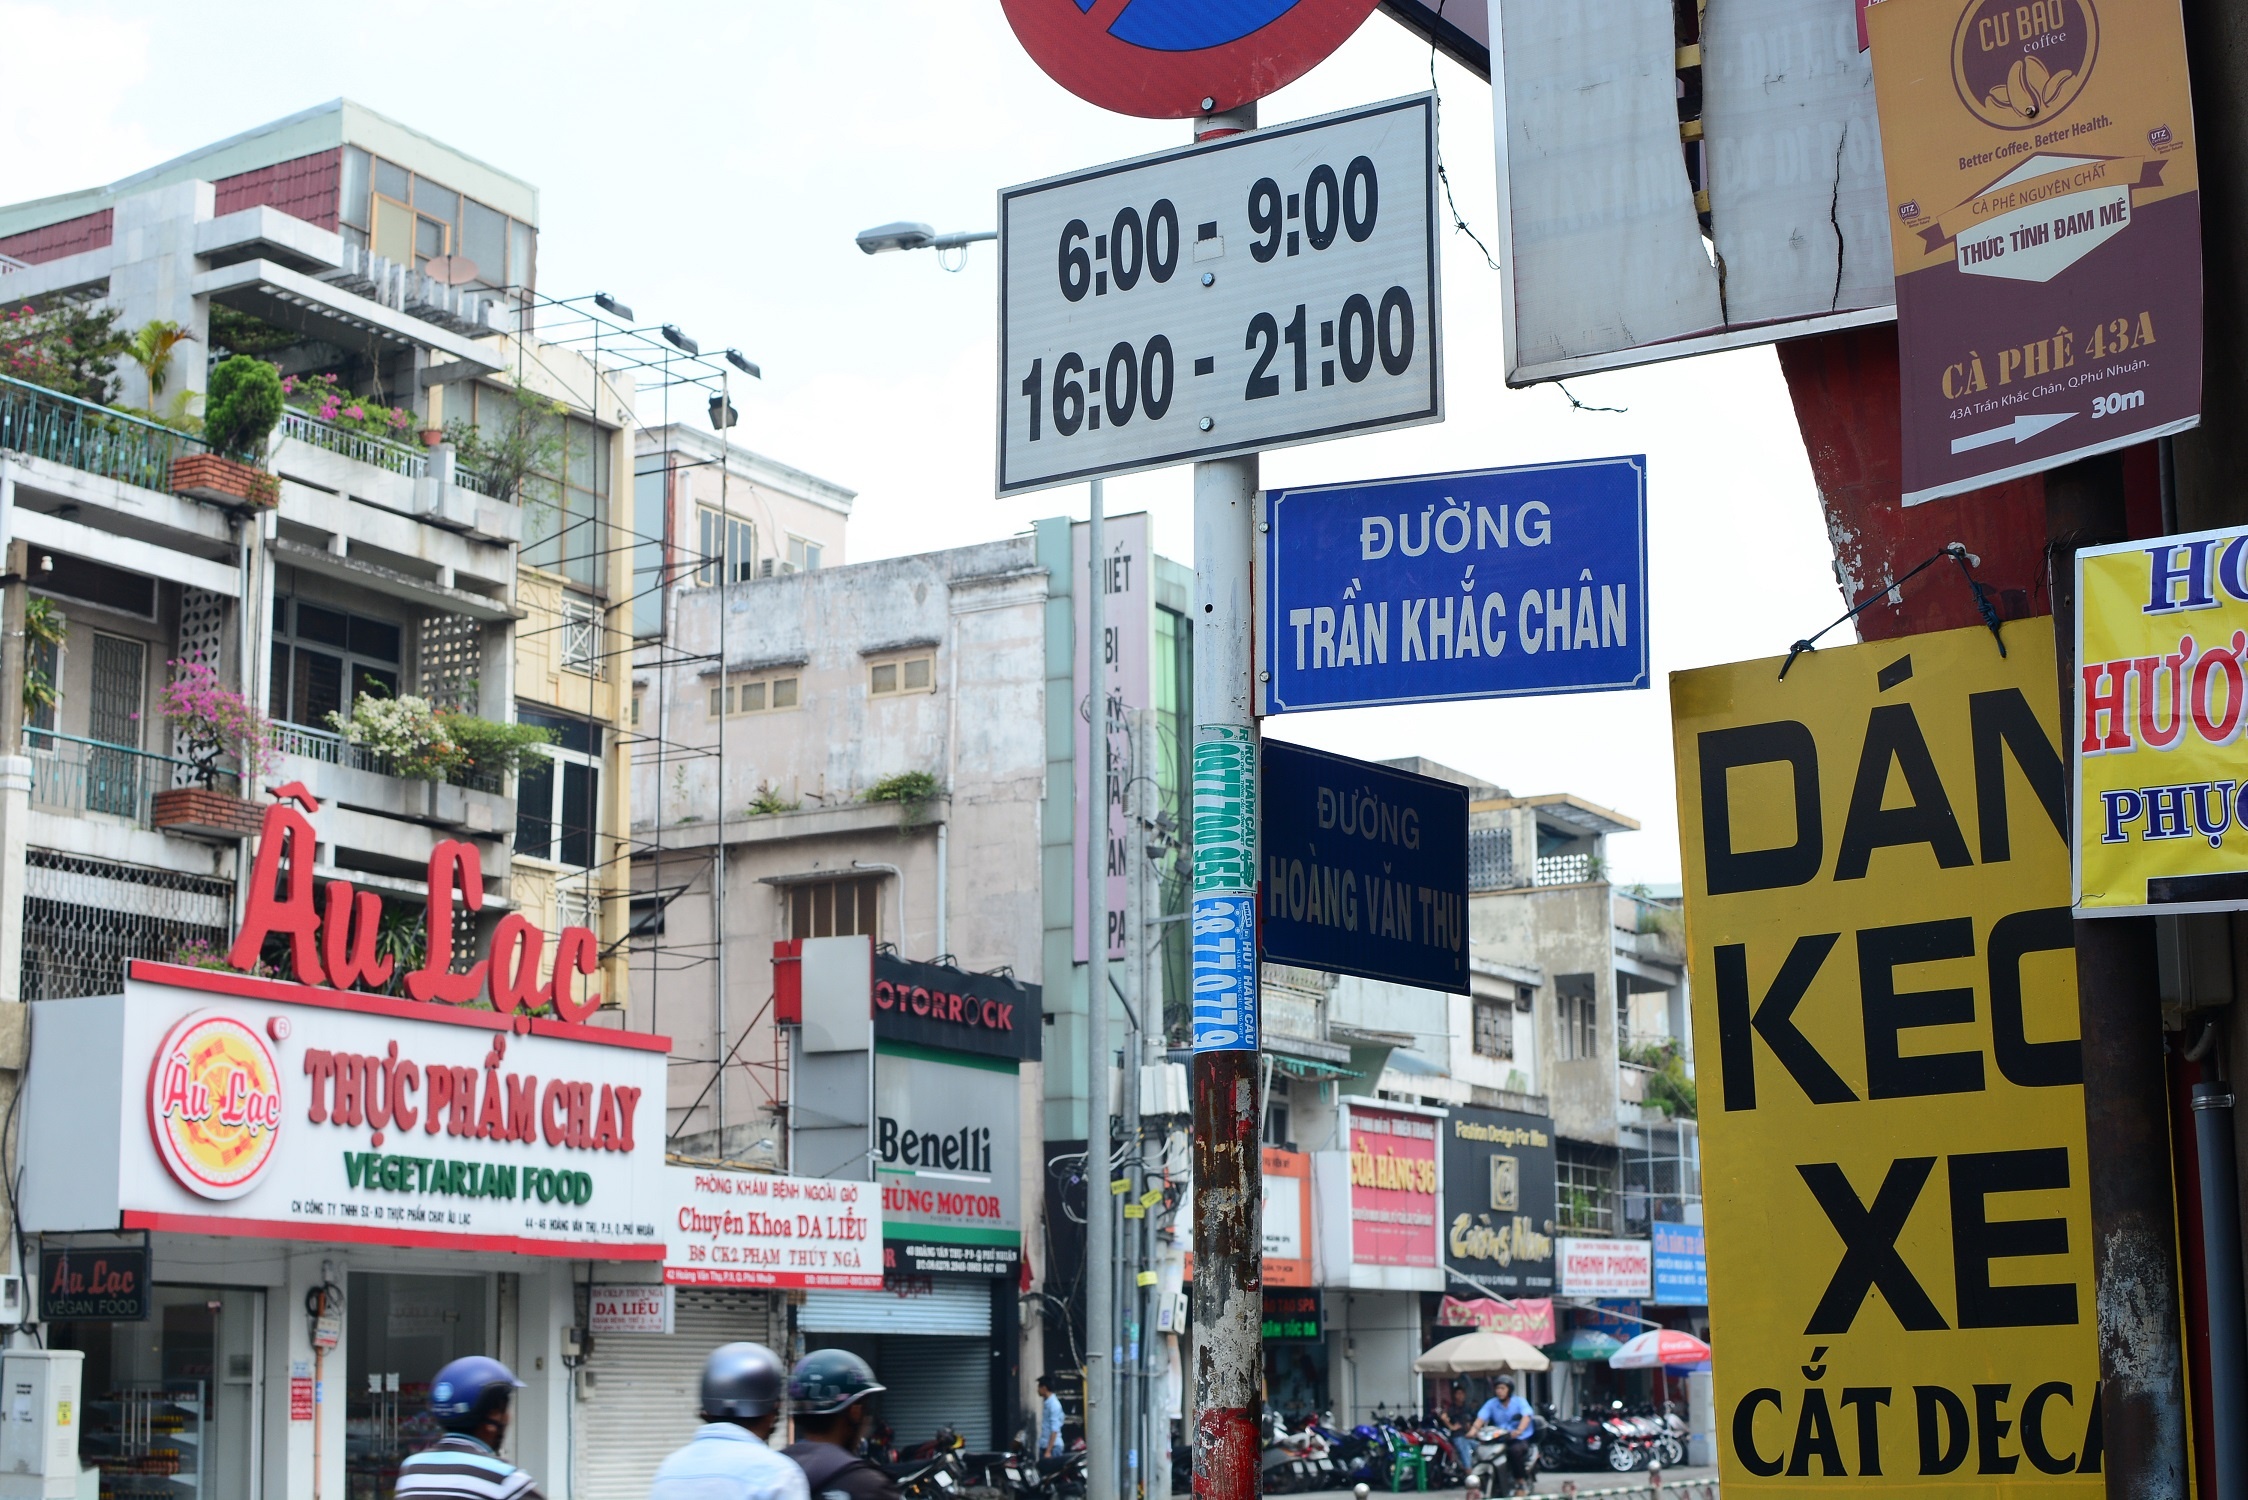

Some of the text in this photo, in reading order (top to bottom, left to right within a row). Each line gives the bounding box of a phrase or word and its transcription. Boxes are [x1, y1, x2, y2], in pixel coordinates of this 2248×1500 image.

[2023, 32, 2068, 54] coffee
[1958, 113, 2114, 171] Better Coffee. Better Health.
[2151, 130, 2166, 140] UTZ
[1901, 204, 1915, 214] UTZ
[1971, 164, 2107, 215] CÀ PHÊ NGUYÊN CHẤT
[1058, 198, 1180, 303] 6:00
[1247, 155, 1379, 264] 9:00
[1961, 198, 2128, 266] THỨC TỈNH ĐAM MÊ
[1022, 334, 1174, 442] 16:00
[1245, 285, 1415, 401] 21:00
[1941, 311, 2157, 400] CÀ PHÊ 43A
[1949, 405, 1972, 420] 43A
[2001, 389, 2030, 407] Khắc
[2031, 381, 2066, 399] Chân,
[2068, 369, 2104, 389] Q.Phú
[2105, 358, 2151, 380] Nhuận.
[2091, 389, 2145, 420] 30m
[1359, 496, 1552, 561] ĐƯỜNG
[1289, 564, 1627, 671] TRẦN KHẮC CHÂN
[1245, 744, 1257, 848] RÚT HẦM CẦU
[1316, 786, 1420, 851] ĐƯỜNG
[227, 782, 601, 1035] Âu Lạc
[1269, 843, 1462, 971] HOÀNG VĂN THỤ
[876, 979, 1014, 1032] OTORROCK
[1242, 940, 1256, 1045] HÚT HẦM CẦU
[163, 1051, 281, 1136] Âu Lạc
[304, 1033, 642, 1152] THỰC PHẨM CHAY
[877, 1116, 992, 1175] Benelli
[1455, 1119, 1549, 1149] Fashion Design For Men
[344, 1151, 594, 1206] VEGETARIAN FOOD
[695, 1174, 859, 1203] PHÒNG KHÁM BỆNH NGOÀI GIỜ
[1376, 1146, 1415, 1192] HÀNG
[1416, 1158, 1436, 1195] 36
[305, 1199, 324, 1215] CÔNG
[327, 1202, 336, 1216] TY
[340, 1203, 358, 1217] TNHH
[428, 1210, 445, 1225] CHAY
[678, 1206, 744, 1241] Chuyên
[748, 1210, 792, 1238] Khoa
[797, 1214, 823, 1239] DA
[937, 1192, 1002, 1219] MOTOR
[688, 1244, 706, 1262] BS
[711, 1246, 738, 1263] CK2
[743, 1247, 781, 1269] PHẠM
[789, 1245, 828, 1267] THÚY
[1795, 1146, 2080, 1336] XE
[47, 1299, 139, 1315] VEGAN FOOD
[88, 1259, 136, 1299] Lạc
[1297, 1297, 1316, 1313] SPA
[595, 1302, 617, 1315] DA
[1731, 1345, 1893, 1478] CẮT
